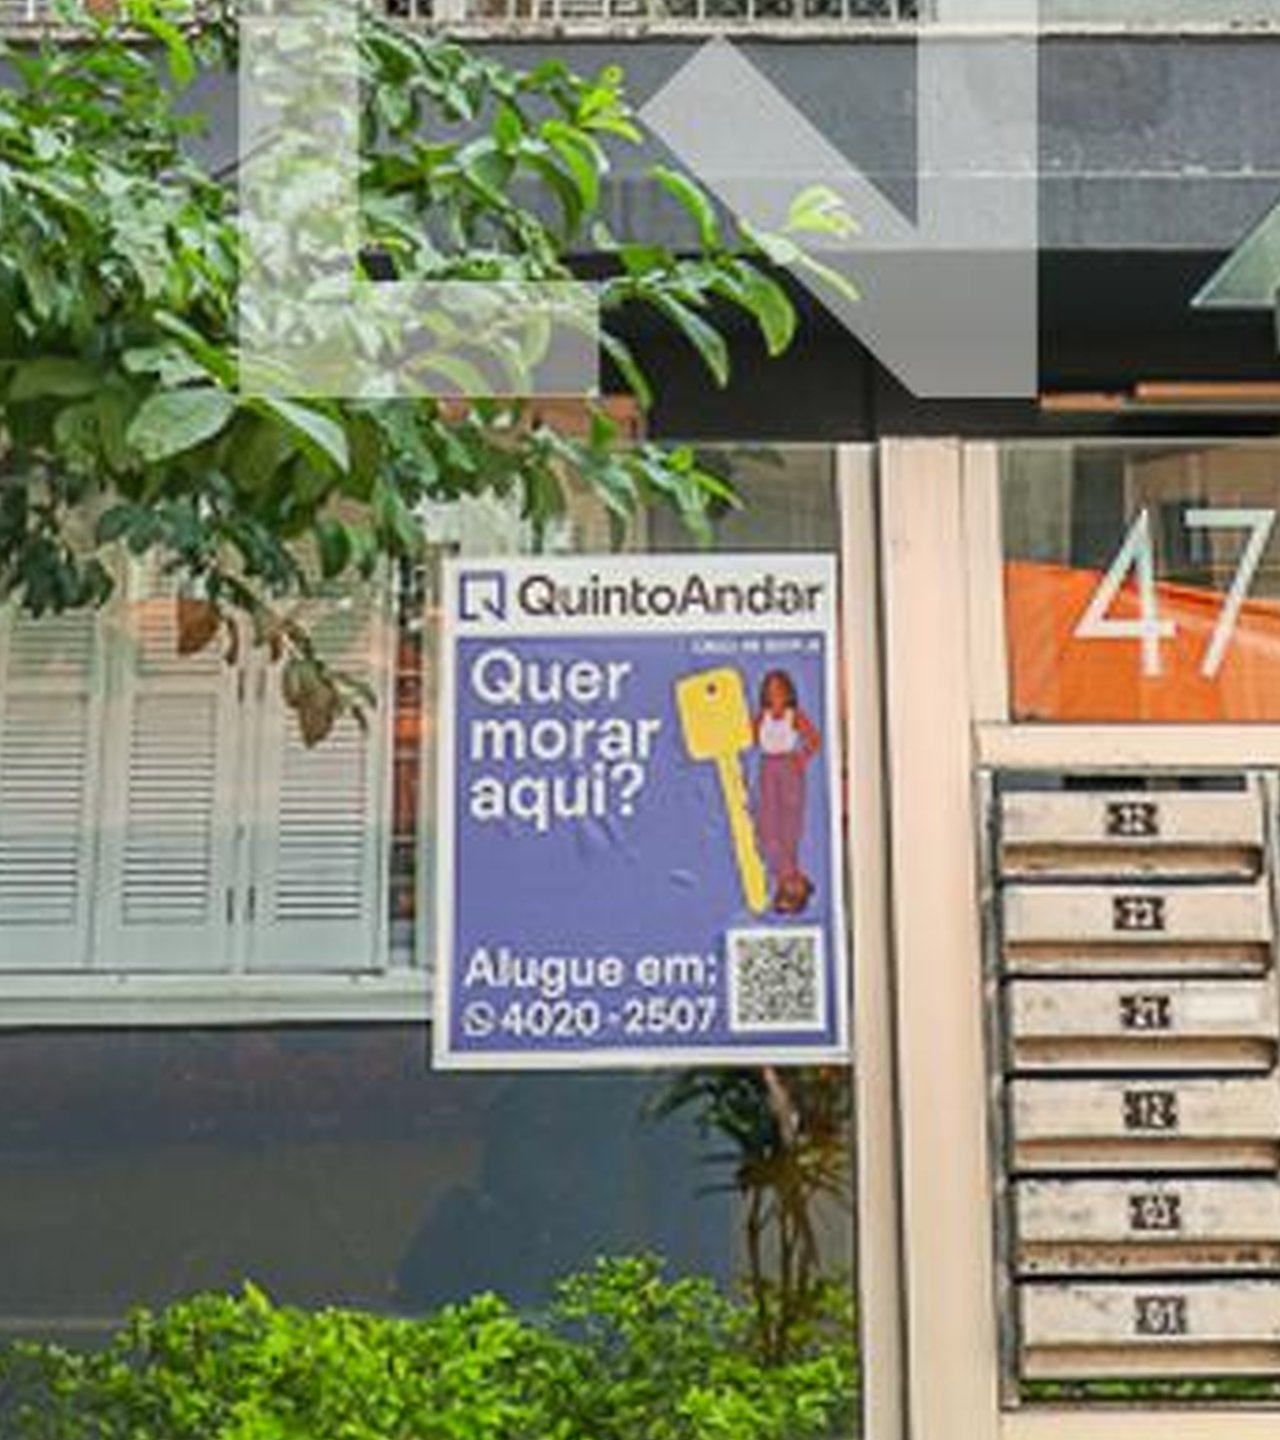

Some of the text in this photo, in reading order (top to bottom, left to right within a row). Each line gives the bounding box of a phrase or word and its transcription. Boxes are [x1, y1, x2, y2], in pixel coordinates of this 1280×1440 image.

[519, 573, 823, 617] QuintoAndar
[471, 650, 632, 703] Quer
[470, 719, 660, 758] morar
[469, 763, 646, 830] aqui?
[464, 948, 717, 999] Alugue em:
[502, 1000, 601, 1037] 4020
[623, 996, 716, 1034] 2507
